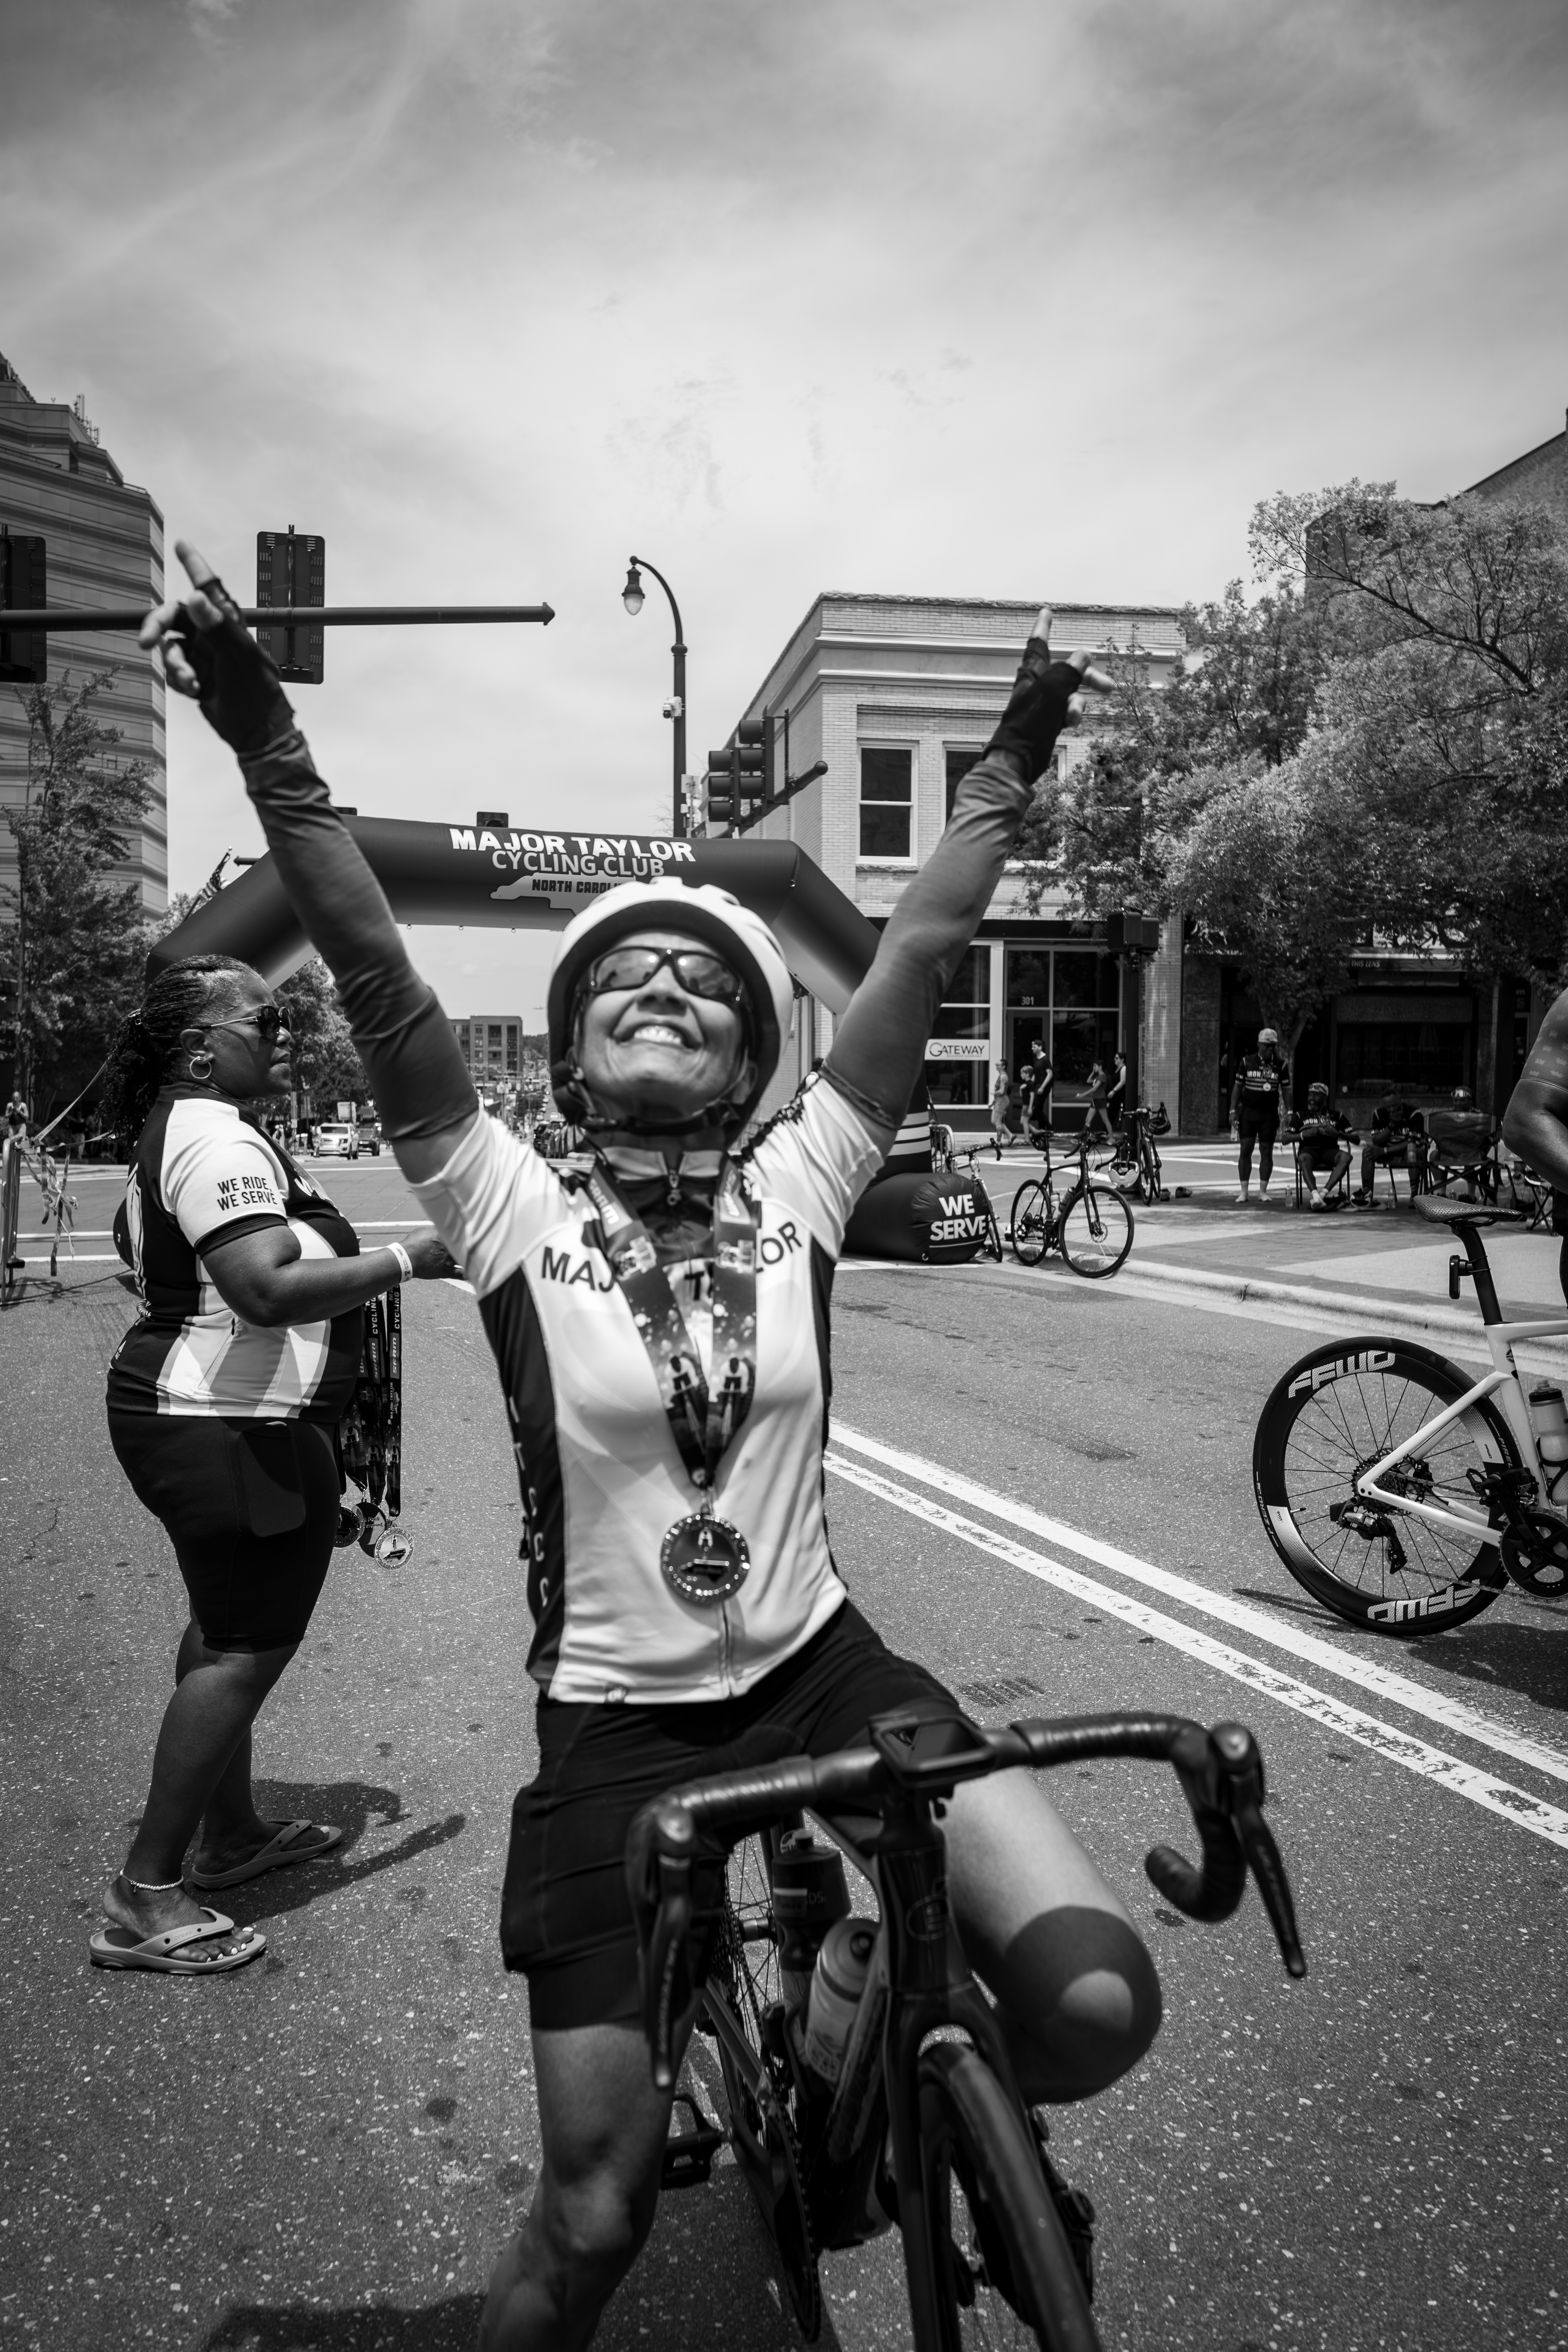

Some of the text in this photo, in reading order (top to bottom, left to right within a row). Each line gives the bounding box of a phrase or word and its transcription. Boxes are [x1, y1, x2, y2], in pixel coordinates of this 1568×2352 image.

[449, 828, 696, 862] MAJOR TAYLOR
[492, 850, 665, 876] CYCLING CLUB
[532, 879, 622, 894] NORTH CARO
[1021, 996, 1034, 1005] 301
[929, 1043, 985, 1057] GATEWAY
[217, 1176, 272, 1194] WE RIDE,
[217, 1191, 277, 1211] WE SERVE
[939, 1194, 975, 1216] WE
[930, 1215, 986, 1241] SERVE
[542, 1246, 615, 1292] MAJ
[1288, 1350, 1395, 1399] FFWD
[1498, 1437, 1513, 1469] PIREL
[1258, 1495, 1270, 1526] ZERO
